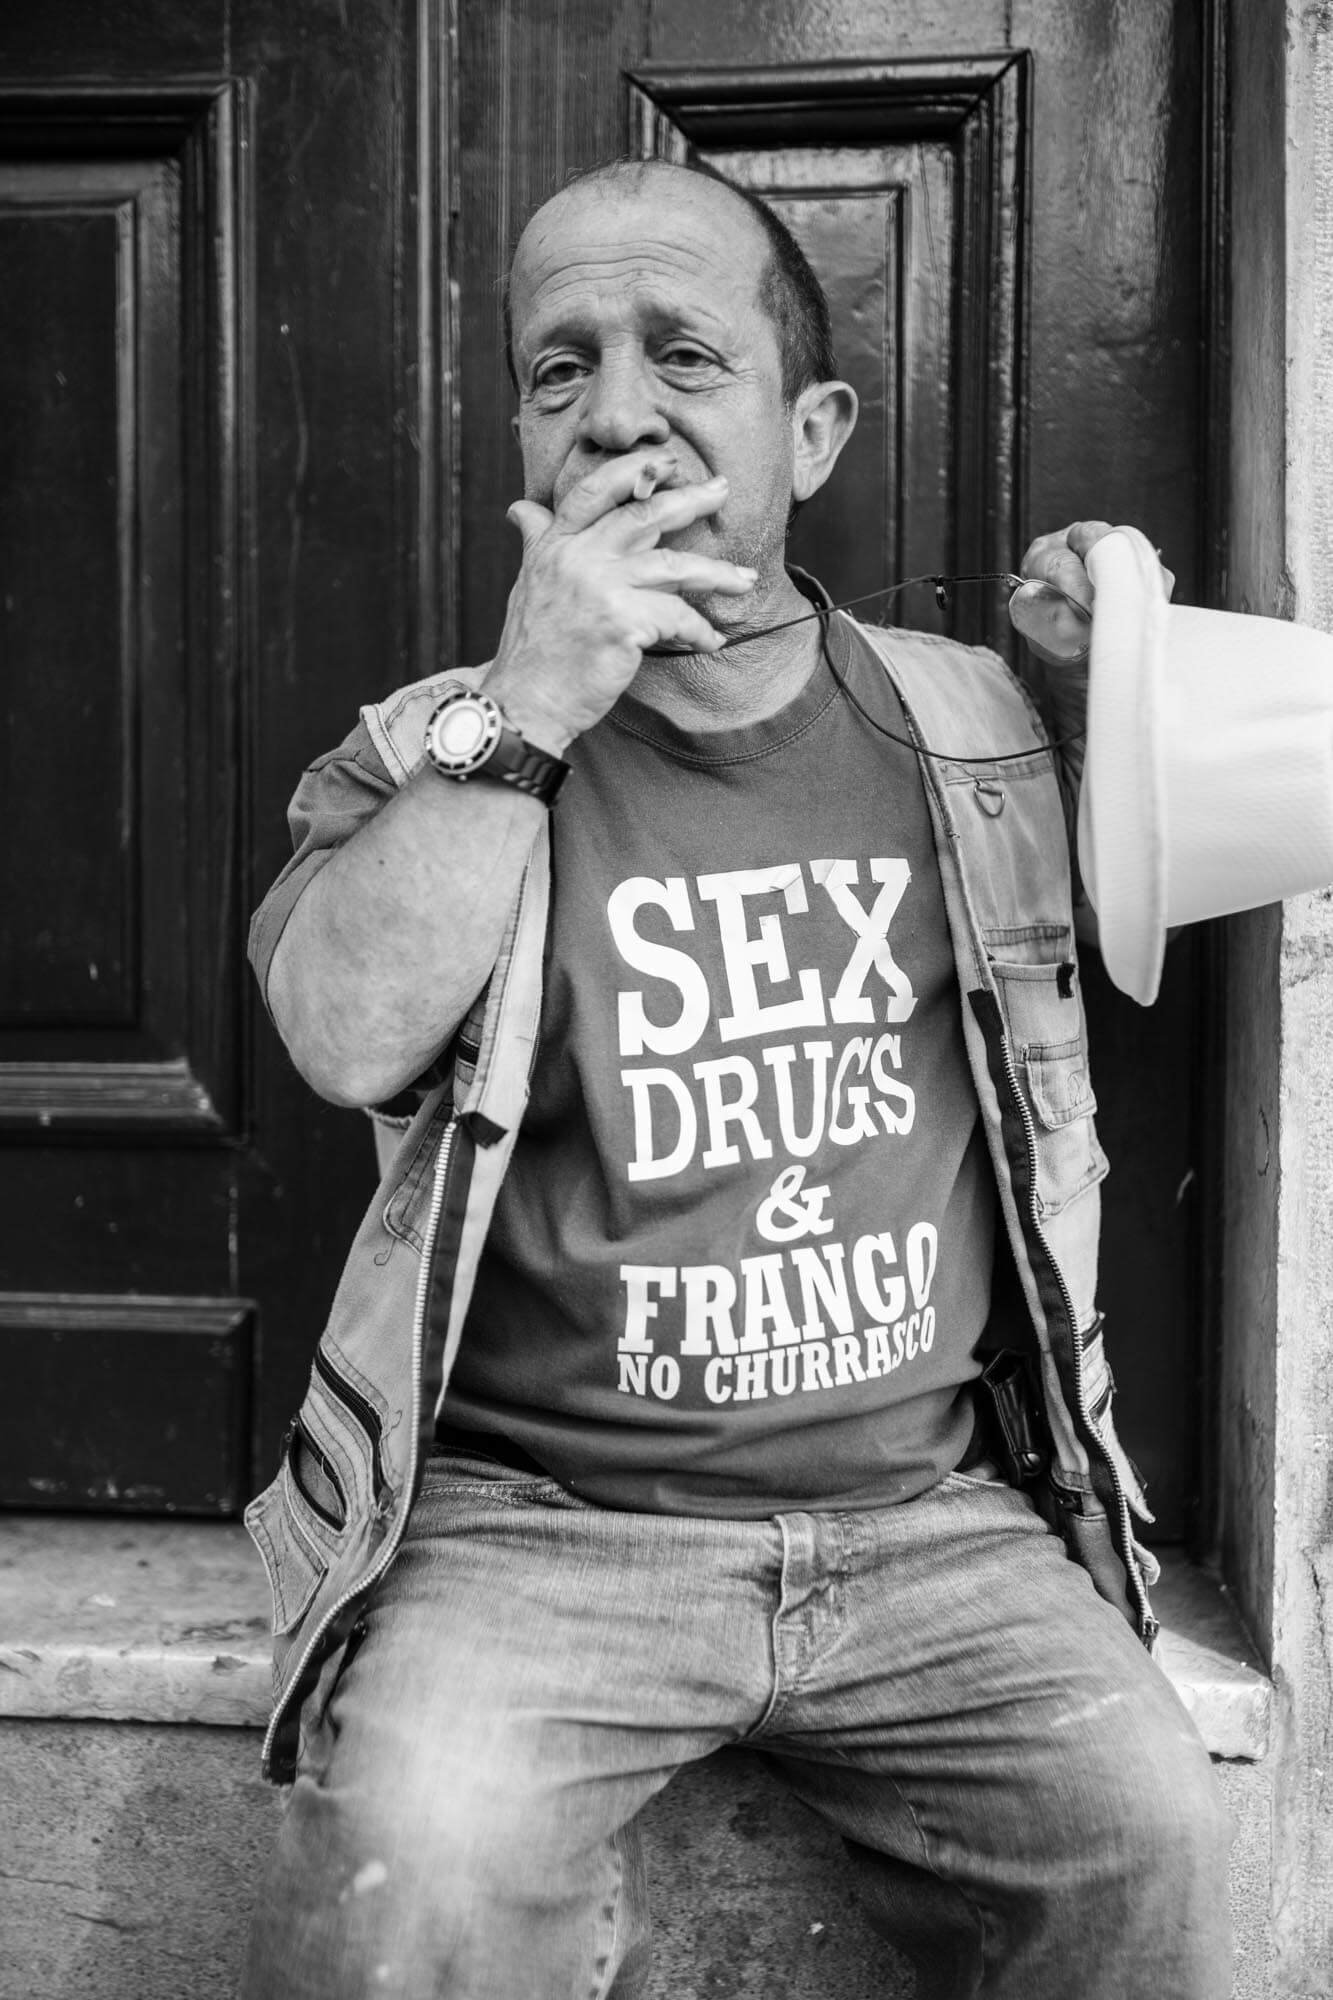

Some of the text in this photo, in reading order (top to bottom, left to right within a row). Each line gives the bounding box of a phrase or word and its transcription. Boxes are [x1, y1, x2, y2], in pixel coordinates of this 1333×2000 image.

[607, 858, 918, 1056] SEX
[621, 1033, 916, 1181] DRUGS
[756, 1165, 834, 1242] &
[617, 1222, 938, 1355] FRANGO
[617, 1306, 936, 1403] NO CHURRASCO
